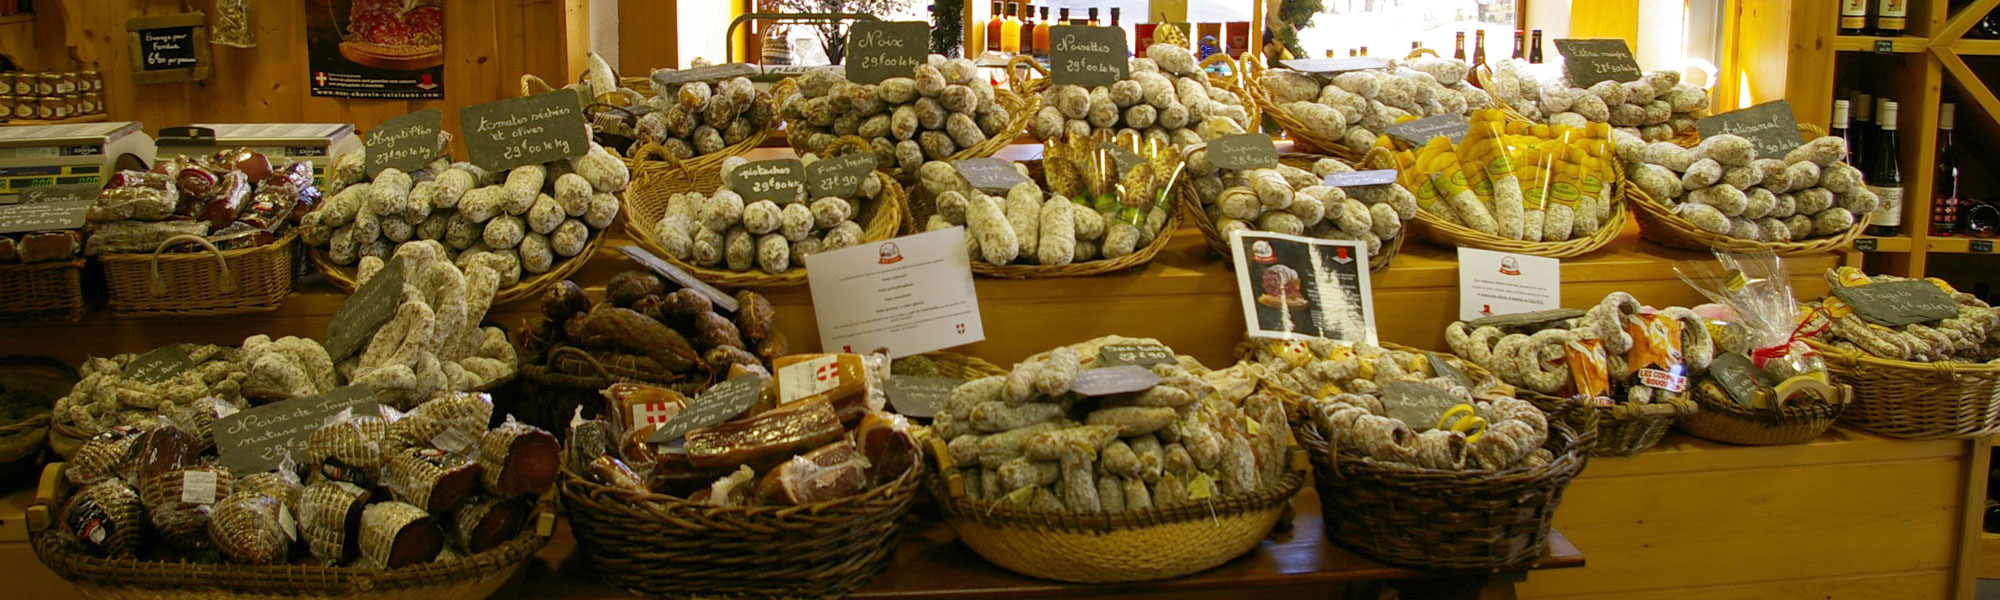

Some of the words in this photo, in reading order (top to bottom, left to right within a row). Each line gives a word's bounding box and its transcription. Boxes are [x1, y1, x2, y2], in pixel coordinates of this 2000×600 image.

[858, 30, 904, 48] Noix
[1056, 34, 1110, 53] Noisettes
[908, 56, 919, 73] kg
[1108, 64, 1121, 81] kg
[493, 131, 505, 140] et
[512, 126, 544, 138] olives
[1717, 115, 1780, 135] Artisanal
[544, 141, 552, 150] le
[555, 139, 570, 154] kg
[1222, 140, 1261, 153] Sapin
[1653, 371, 1676, 383] CORN
[293, 408, 313, 417] de
[238, 428, 297, 446] nature
[262, 437, 309, 460] 28€9
